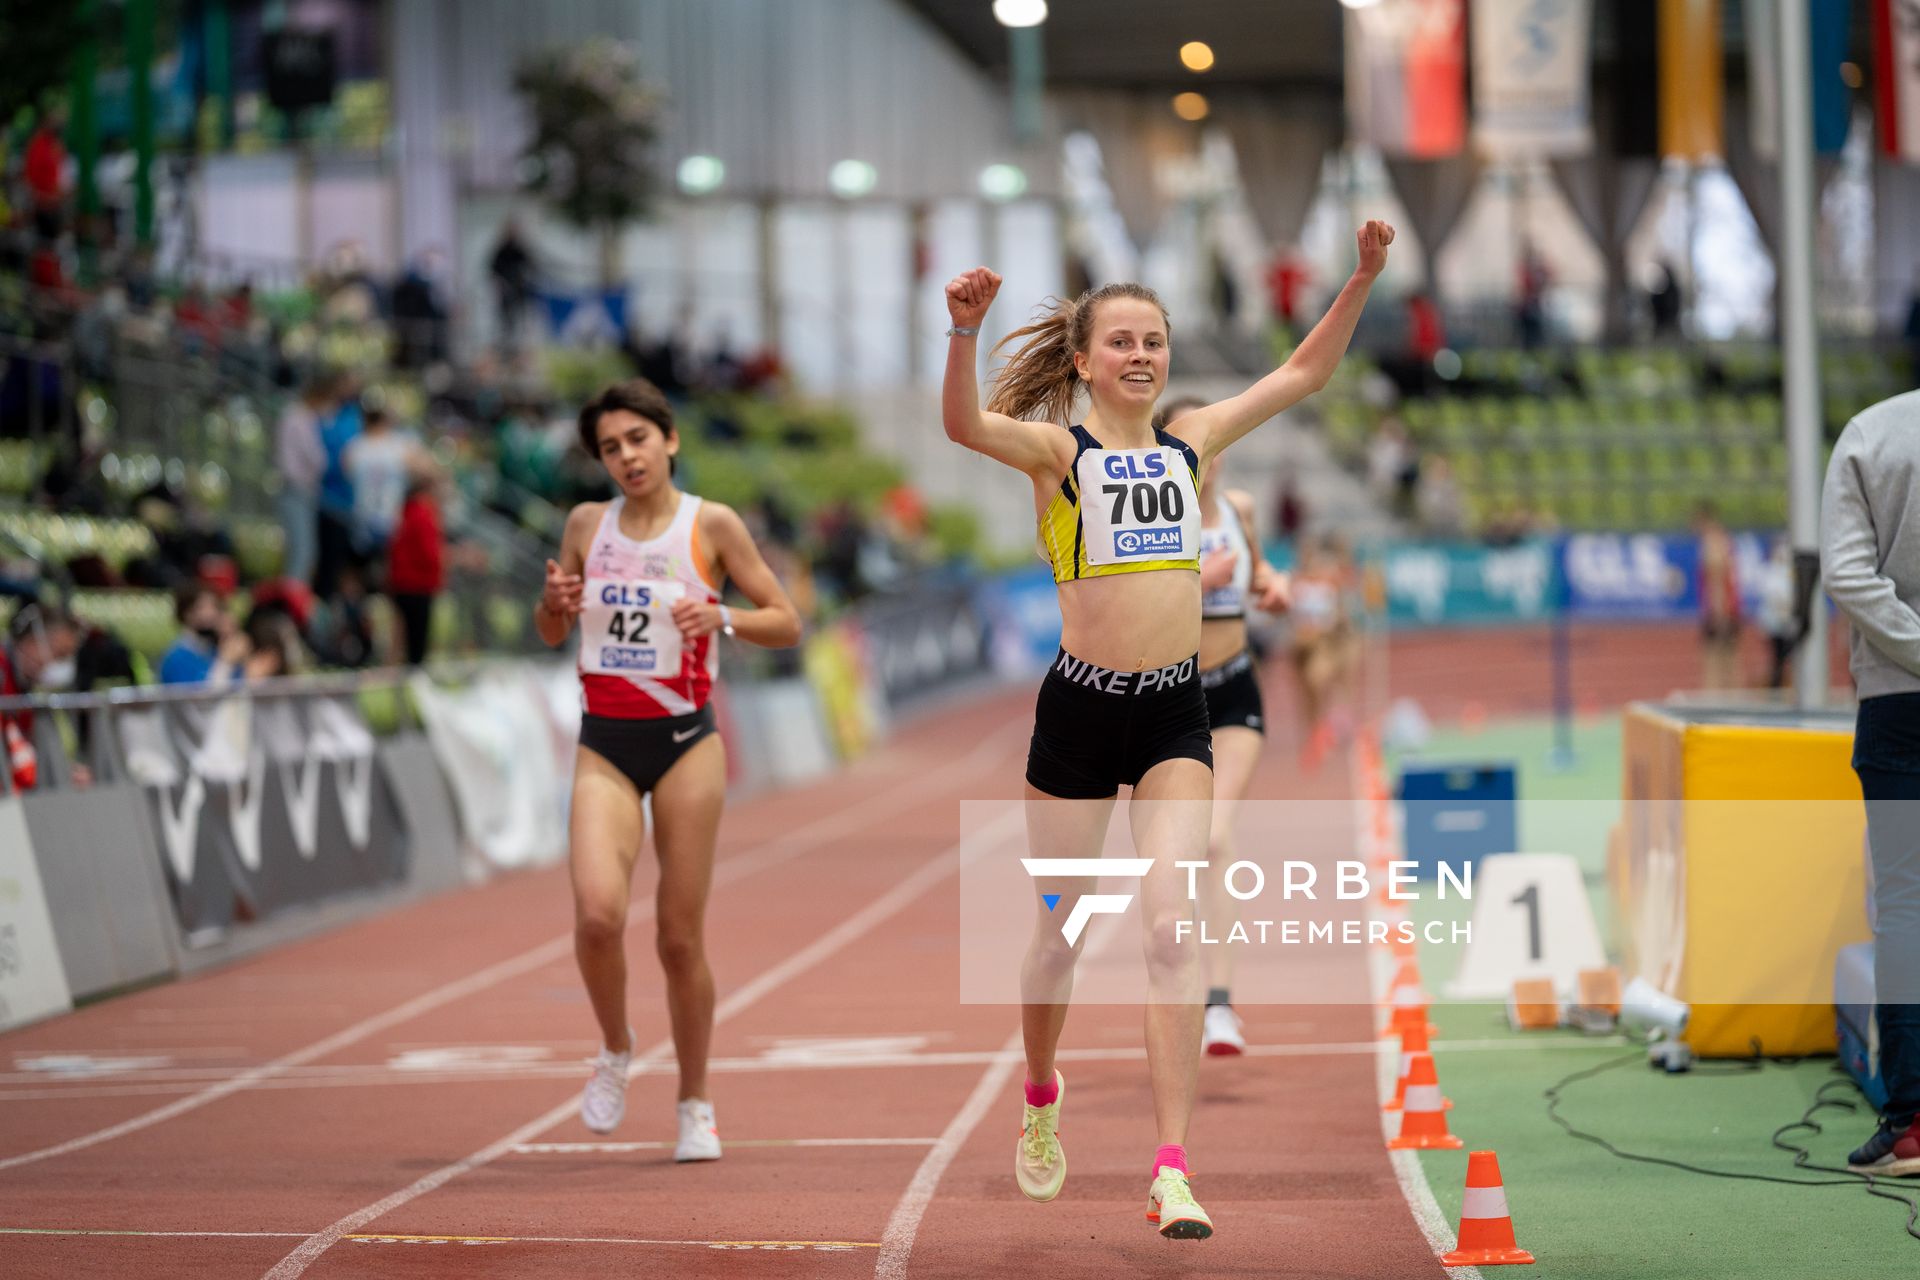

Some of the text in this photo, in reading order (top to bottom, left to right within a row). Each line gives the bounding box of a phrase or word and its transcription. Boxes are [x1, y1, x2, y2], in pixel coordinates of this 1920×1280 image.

[1102, 481, 1184, 525] 700
[1142, 531, 1179, 545] PLAN
[608, 611, 650, 643] 42
[1056, 652, 1133, 695] NIKE
[1134, 657, 1194, 695] PRO
[1511, 885, 1542, 961] 1
